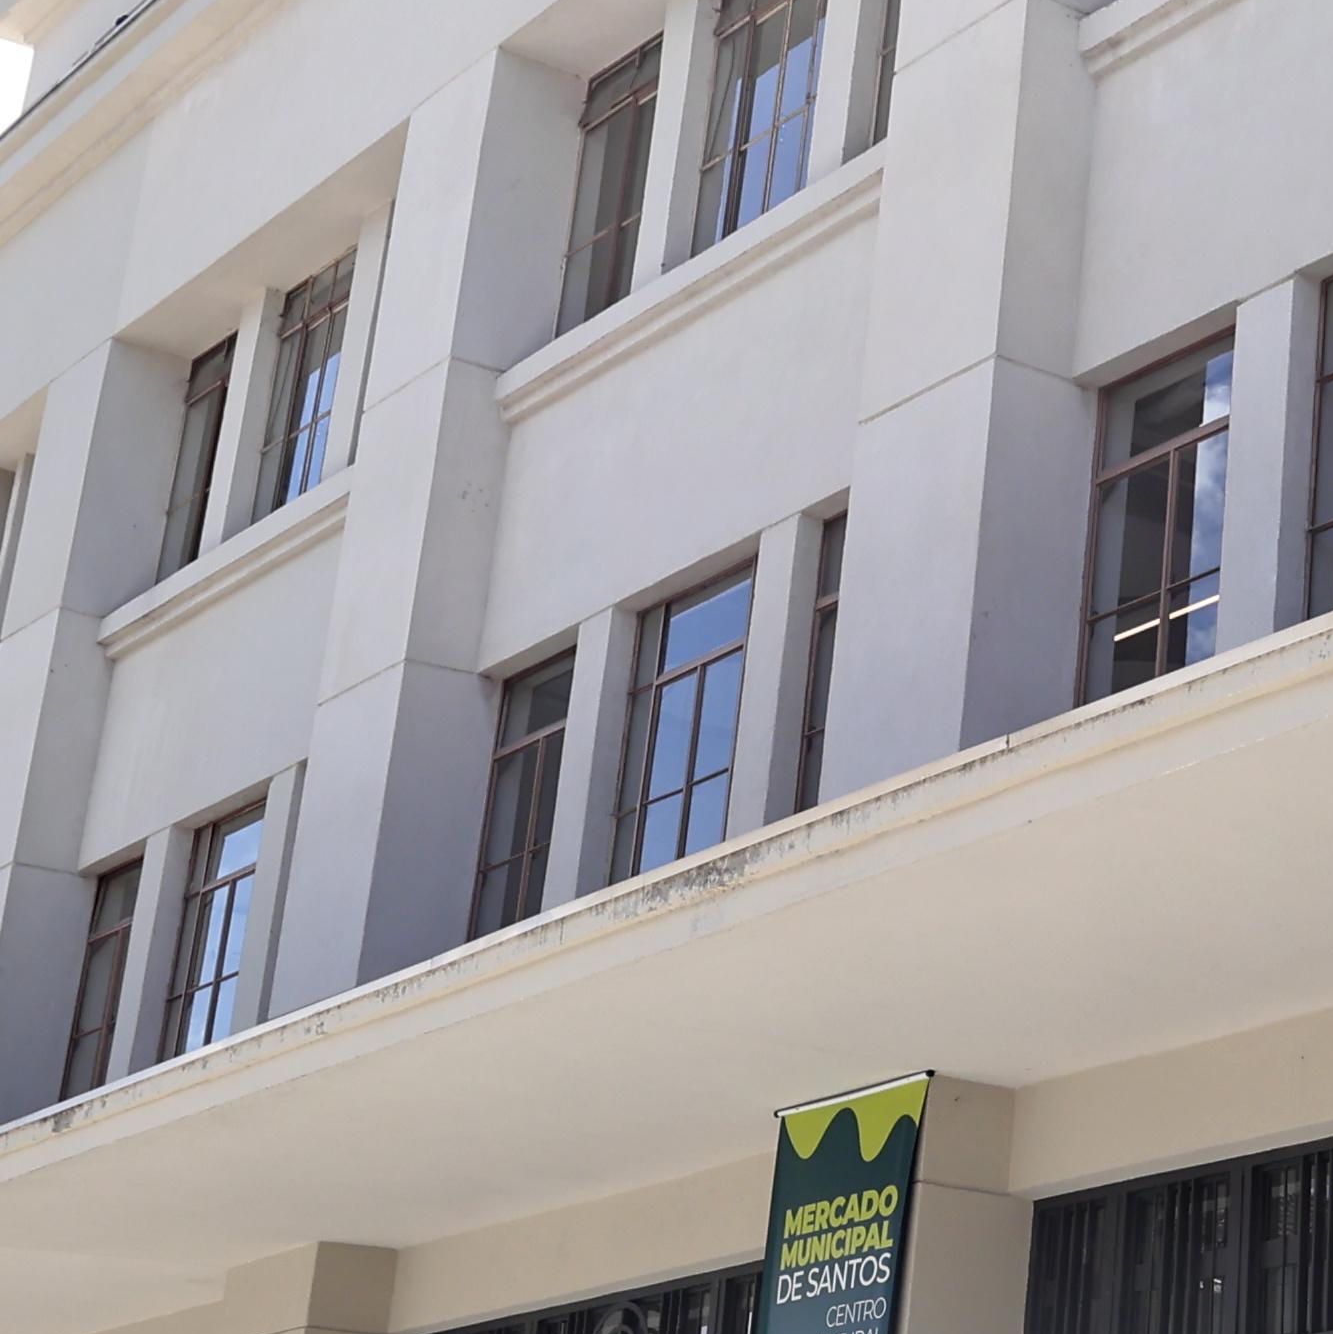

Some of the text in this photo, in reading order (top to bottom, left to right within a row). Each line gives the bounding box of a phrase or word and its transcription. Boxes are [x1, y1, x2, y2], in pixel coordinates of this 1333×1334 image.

[784, 1185, 898, 1239] MERCADO
[780, 1220, 894, 1270] MUNICIPAL
[776, 1252, 891, 1305] DE SANTOS
[826, 1297, 886, 1328] CENTRO
